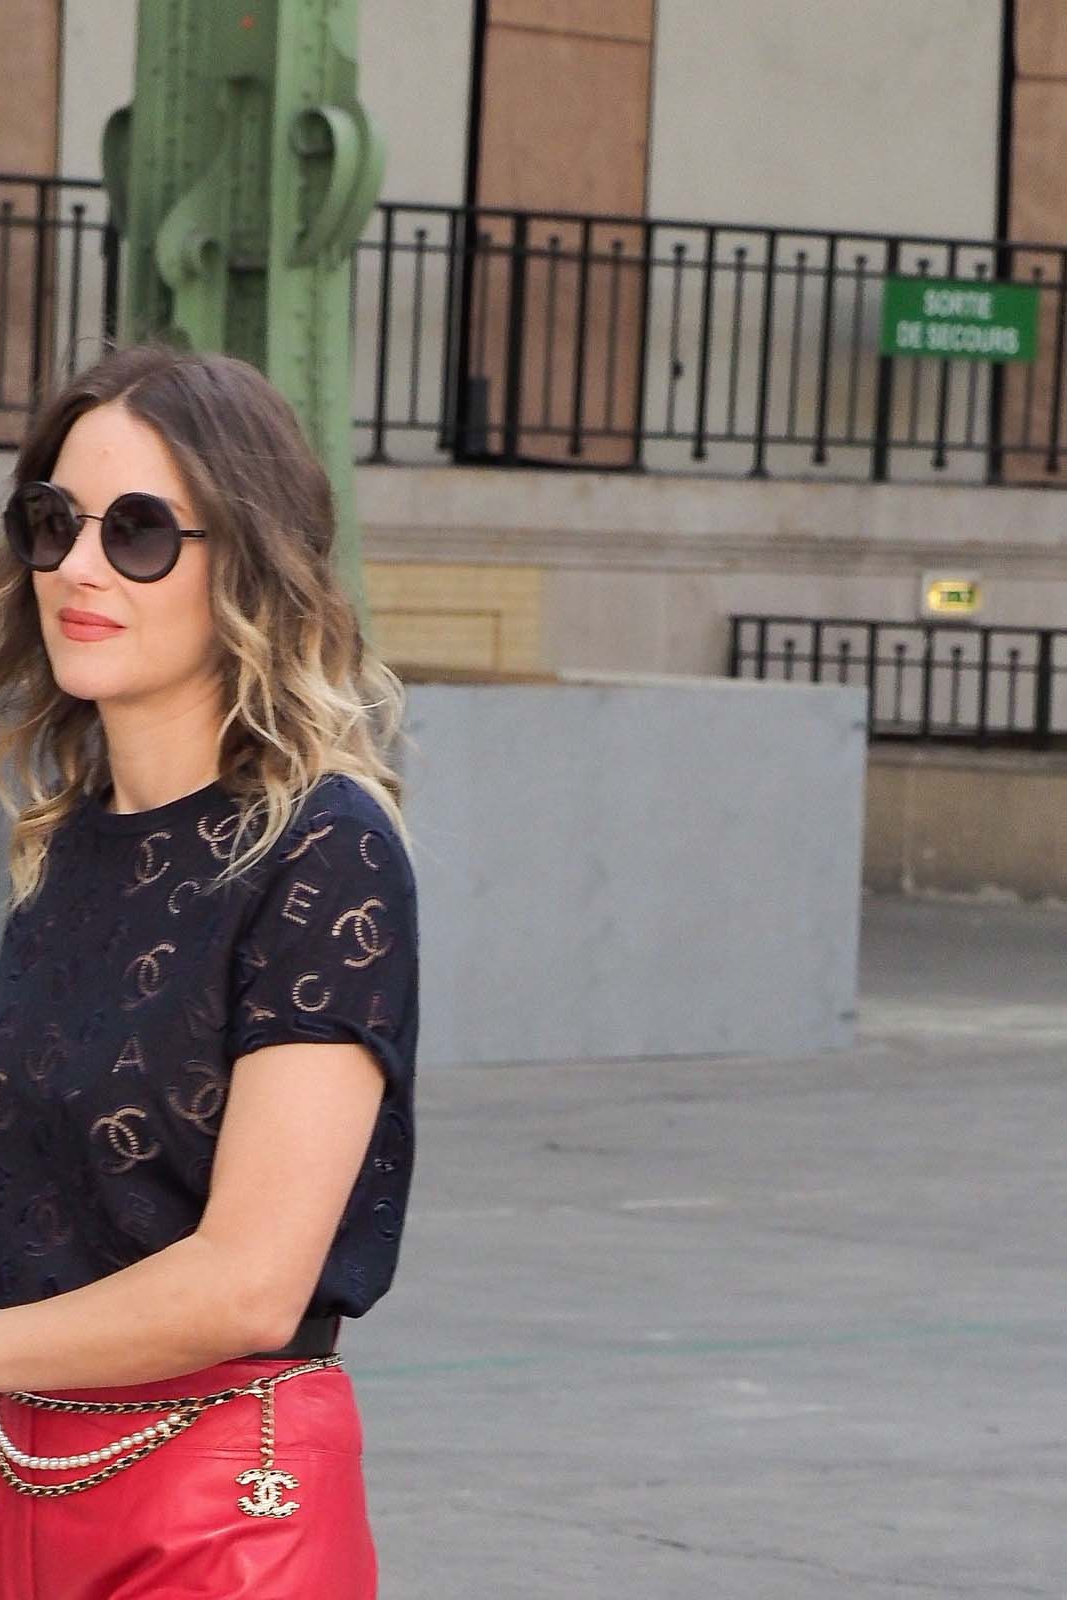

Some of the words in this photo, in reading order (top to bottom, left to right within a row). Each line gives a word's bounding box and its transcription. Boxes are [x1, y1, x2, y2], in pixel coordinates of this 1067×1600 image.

[924, 290, 991, 319] SORTIE
[897, 321, 921, 348] DE
[928, 323, 1019, 354] SECOURS
